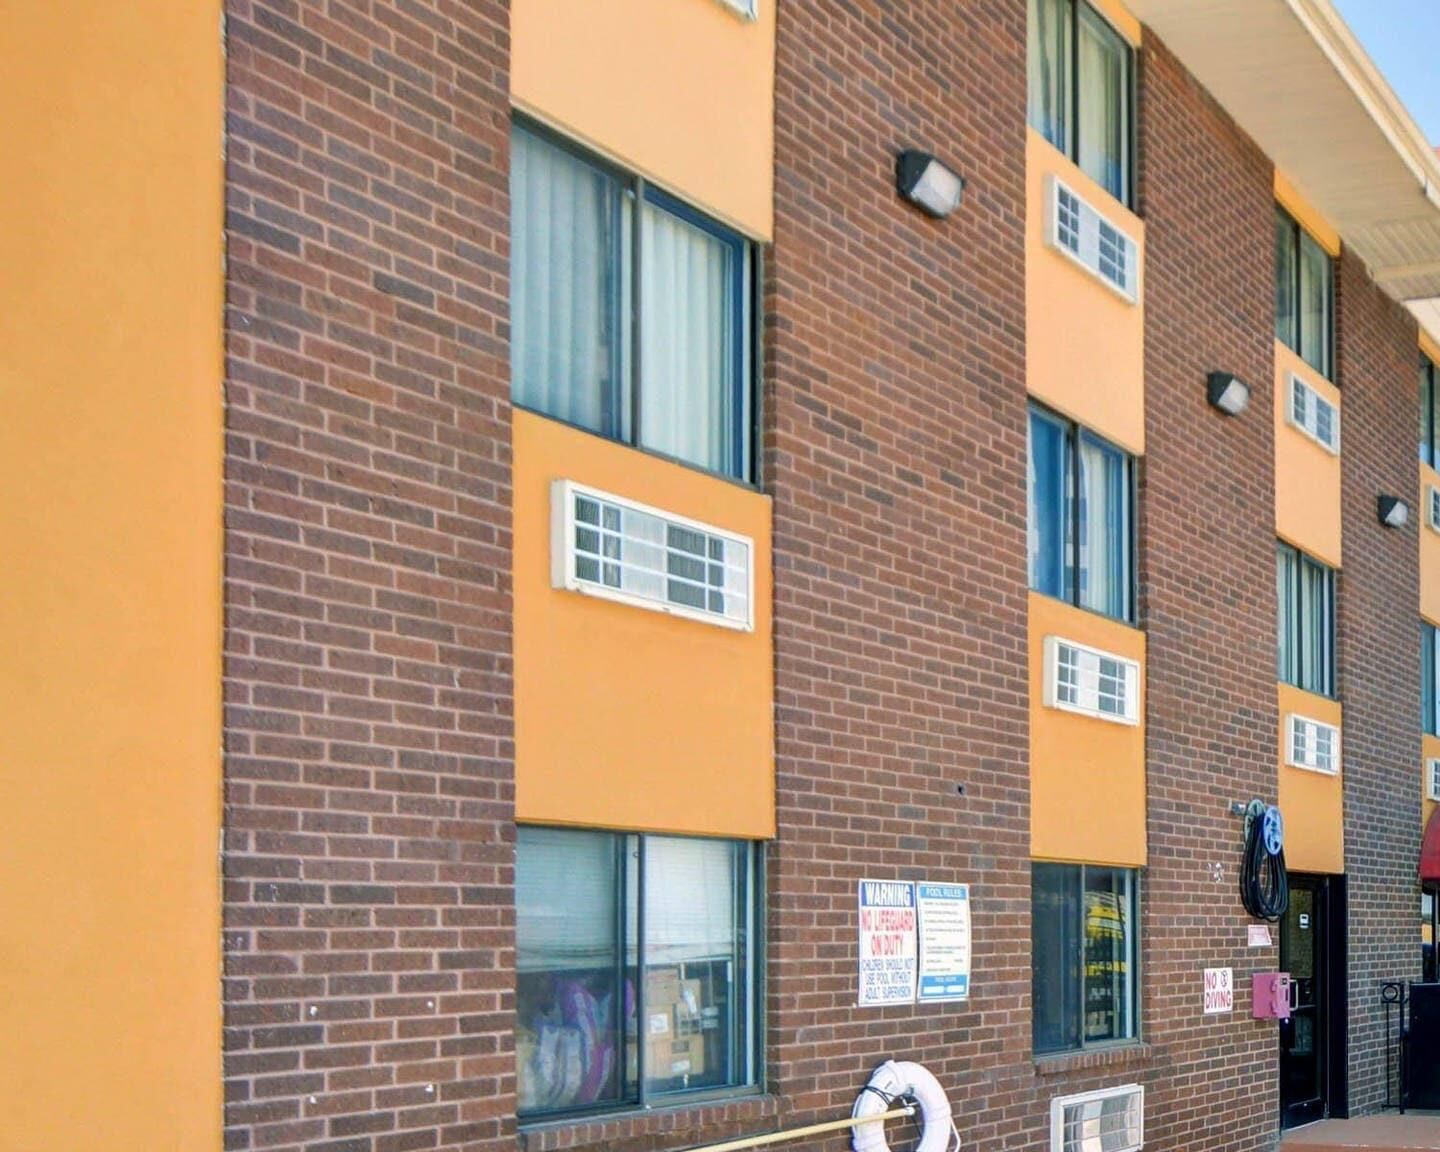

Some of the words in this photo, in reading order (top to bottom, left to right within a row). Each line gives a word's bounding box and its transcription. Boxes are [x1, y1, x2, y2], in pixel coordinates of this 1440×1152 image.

[865, 883, 911, 906] WARNING
[862, 910, 872, 931] NO
[874, 910, 914, 931] LIFEGUARD
[871, 934, 881, 956] ON
[883, 934, 904, 955] DUTY
[1206, 971, 1217, 989] NO
[1206, 990, 1232, 1009] DIVING
